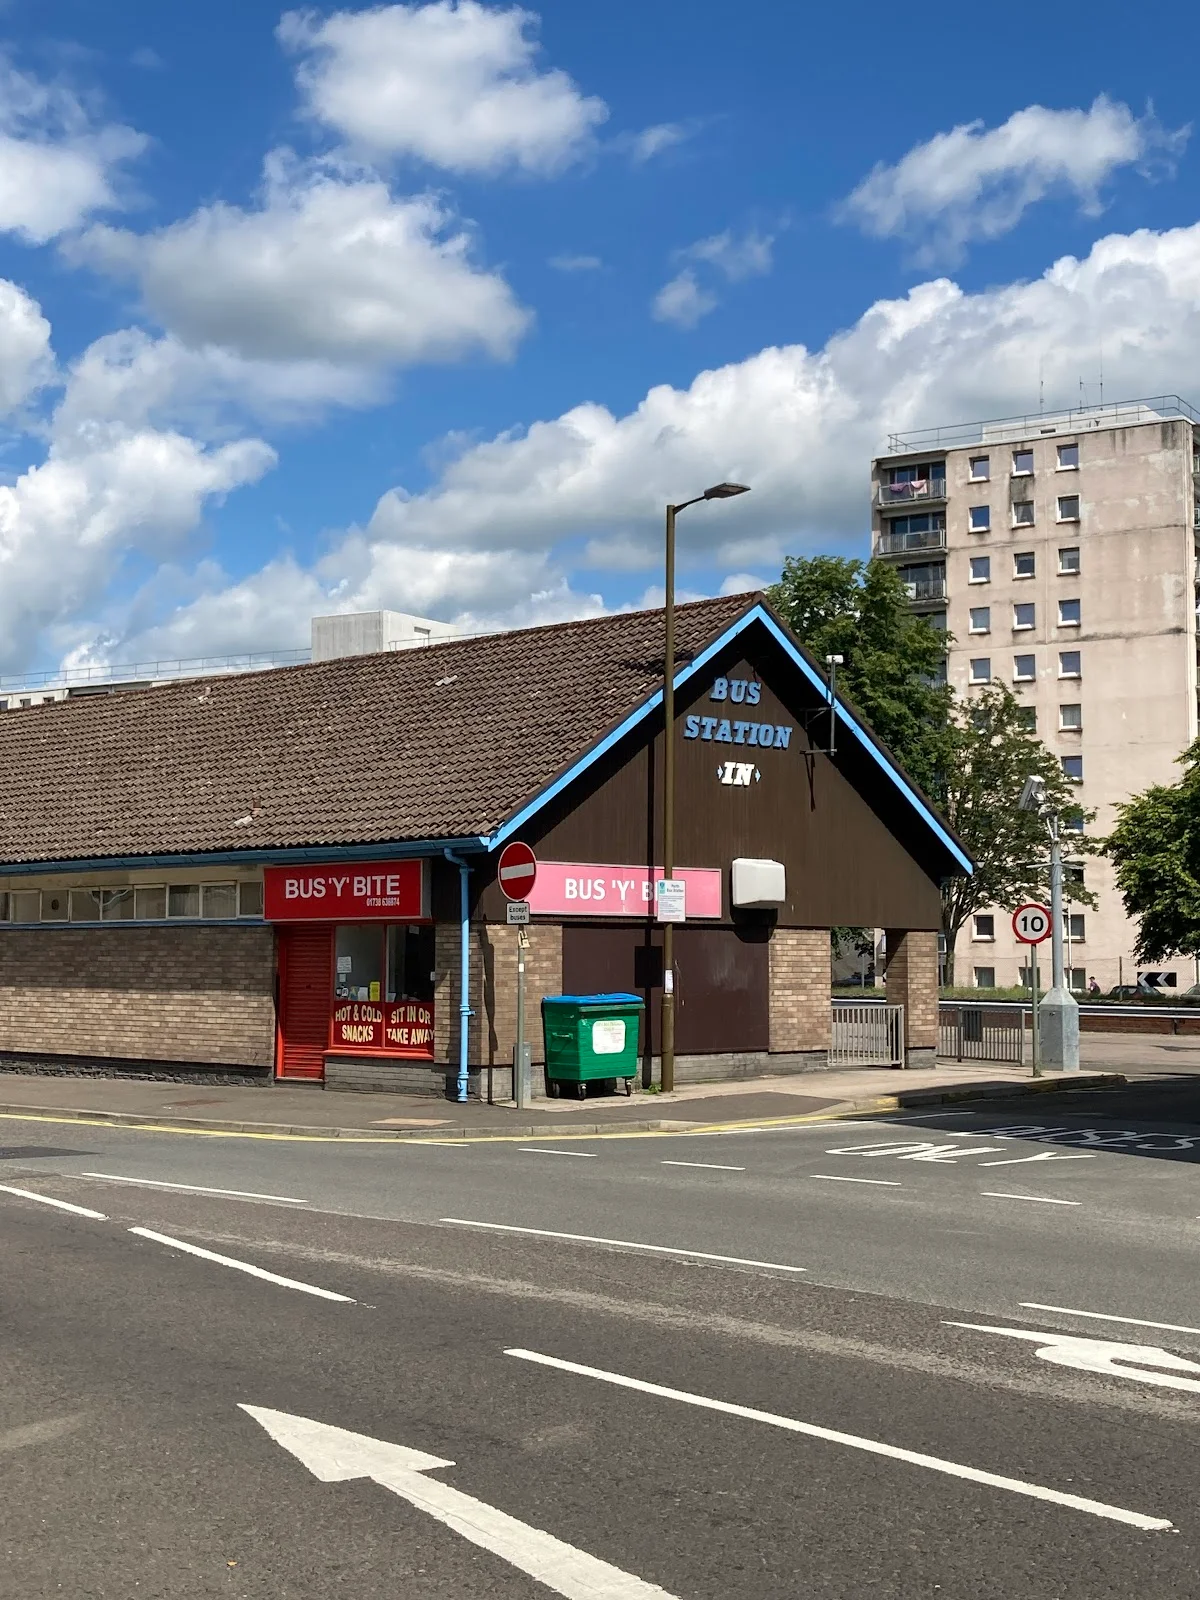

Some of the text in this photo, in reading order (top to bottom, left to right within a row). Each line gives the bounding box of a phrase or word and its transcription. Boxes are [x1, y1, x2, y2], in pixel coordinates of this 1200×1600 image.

[710, 677, 762, 705] BUS
[683, 714, 793, 749] STATION
[721, 761, 755, 786] IN
[285, 878, 326, 899] BUS
[353, 874, 401, 897] BITE
[565, 878, 605, 900] BUS
[508, 905, 528, 914] Except
[1020, 915, 1044, 933] 10
[335, 1004, 383, 1023] HOT & COLD
[390, 1005, 431, 1025] SIT IN OR
[341, 1024, 374, 1043] SNACKS
[386, 1028, 435, 1045] TAKE AWAY
[825, 1140, 1097, 1167] ONLY
